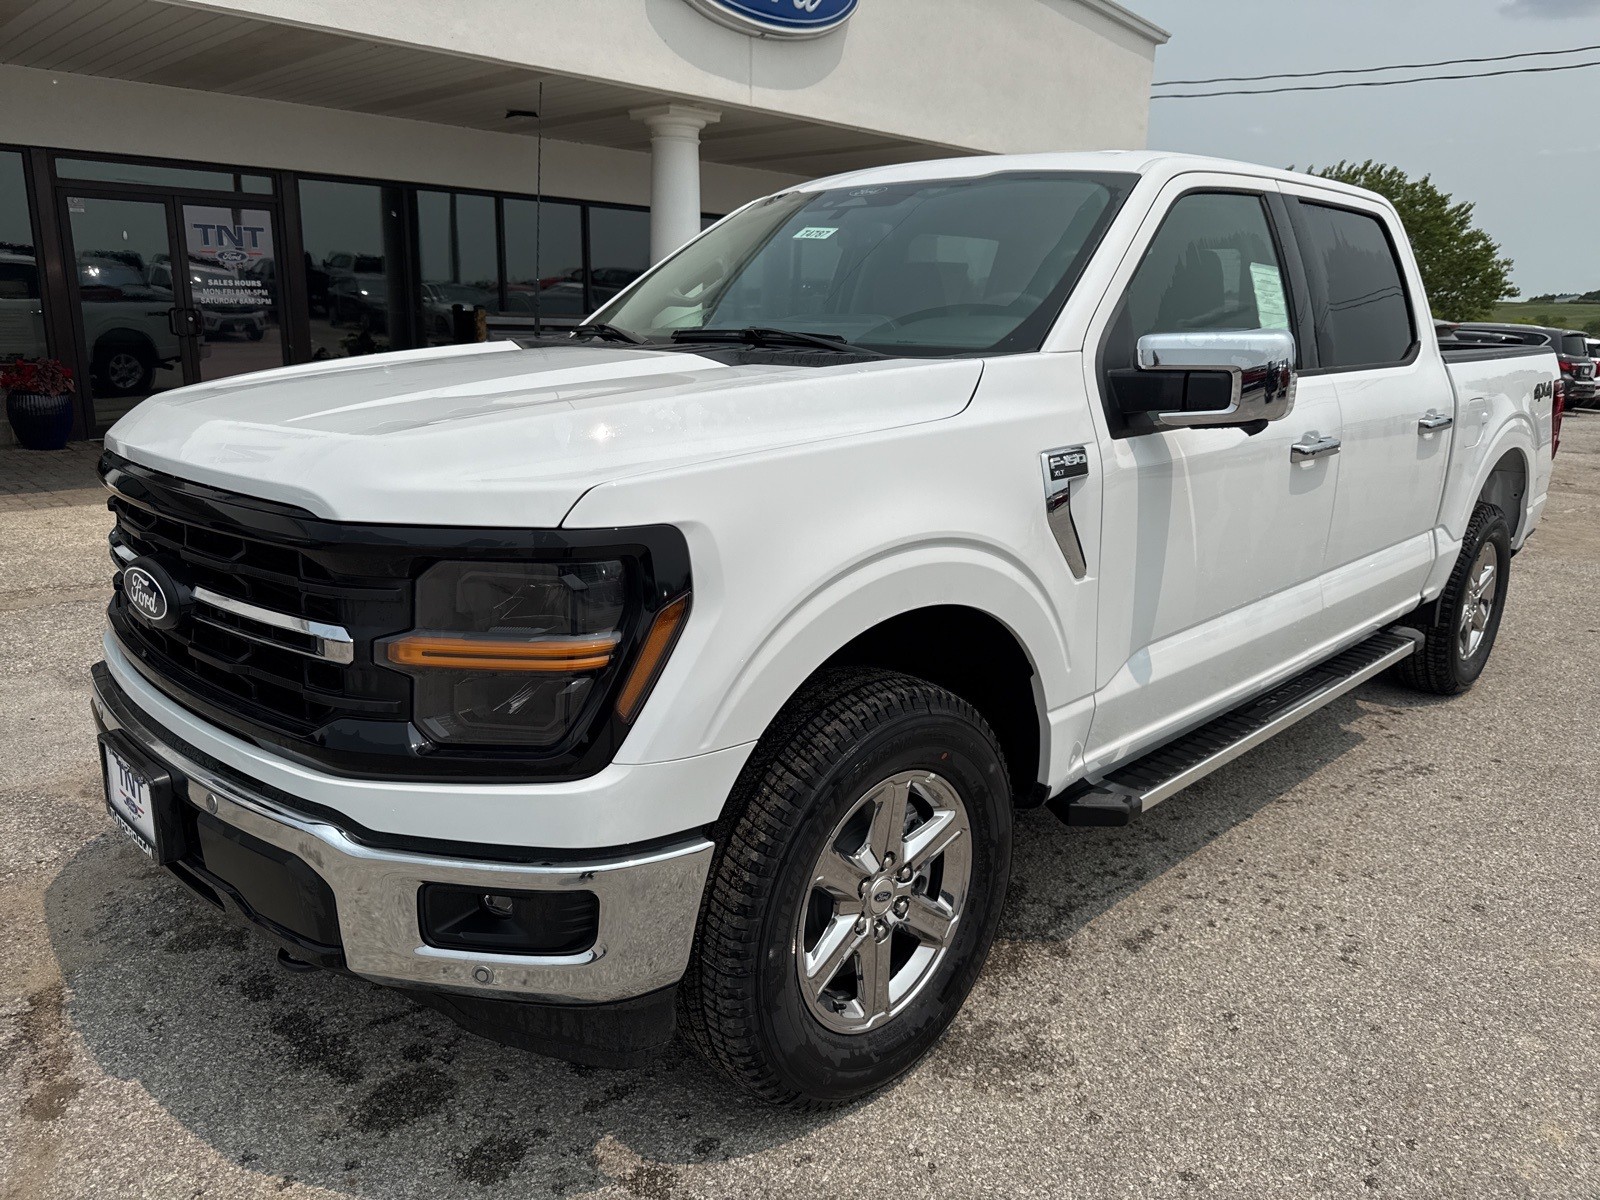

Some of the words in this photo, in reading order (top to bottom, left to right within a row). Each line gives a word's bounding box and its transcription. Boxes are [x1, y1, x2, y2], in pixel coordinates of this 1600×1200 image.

[193, 223, 264, 248] TNT
[222, 252, 242, 261] Ford
[208, 279, 234, 287] SALES
[202, 288, 235, 296] MON-FRI
[1050, 454, 1086, 469] F-150
[131, 573, 158, 614] Ford
[117, 760, 147, 805] TNT
[876, 892, 890, 901] Ford
